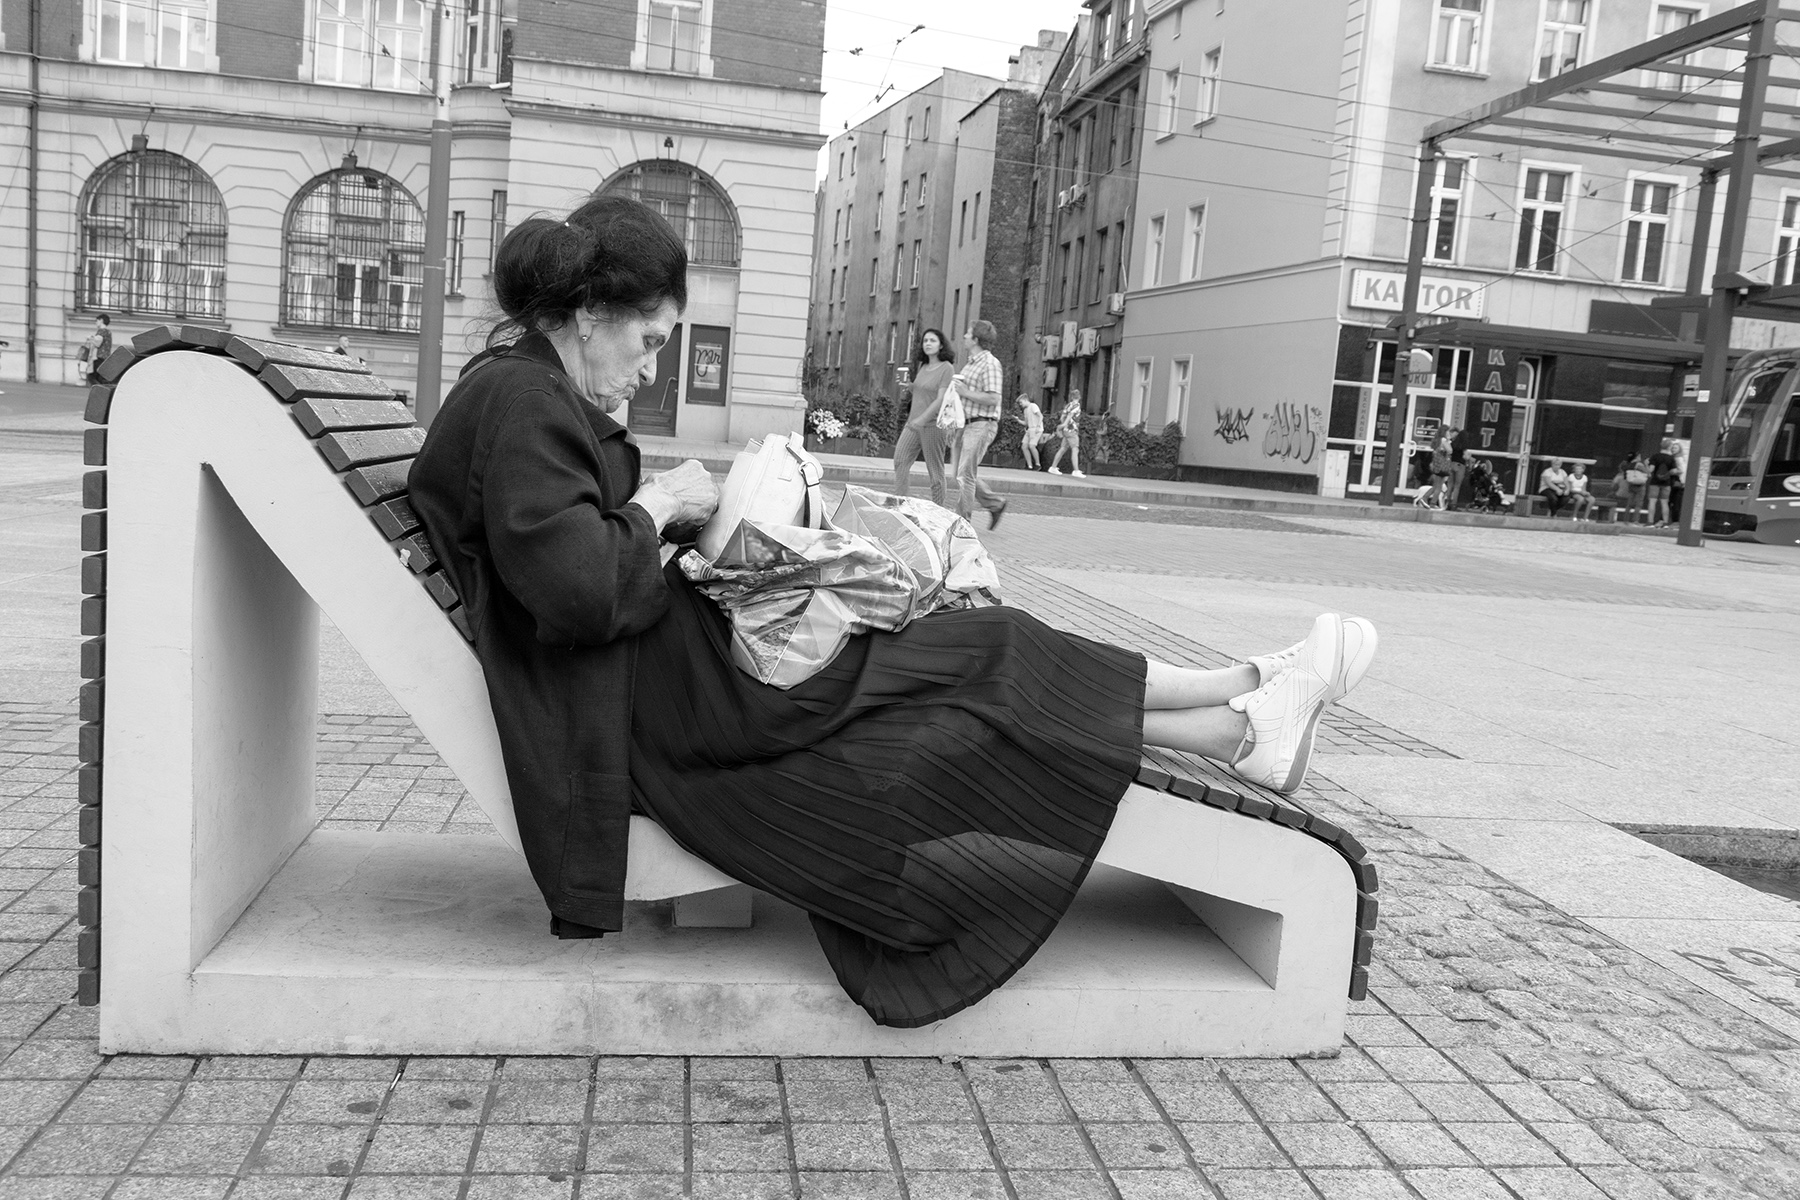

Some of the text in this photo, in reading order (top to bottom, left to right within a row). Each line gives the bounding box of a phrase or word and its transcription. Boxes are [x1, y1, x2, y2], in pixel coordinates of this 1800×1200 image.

[1364, 277, 1473, 310] KATOR
[1359, 391, 1368, 437] EXCHANGE
[1481, 348, 1505, 448] KANT
